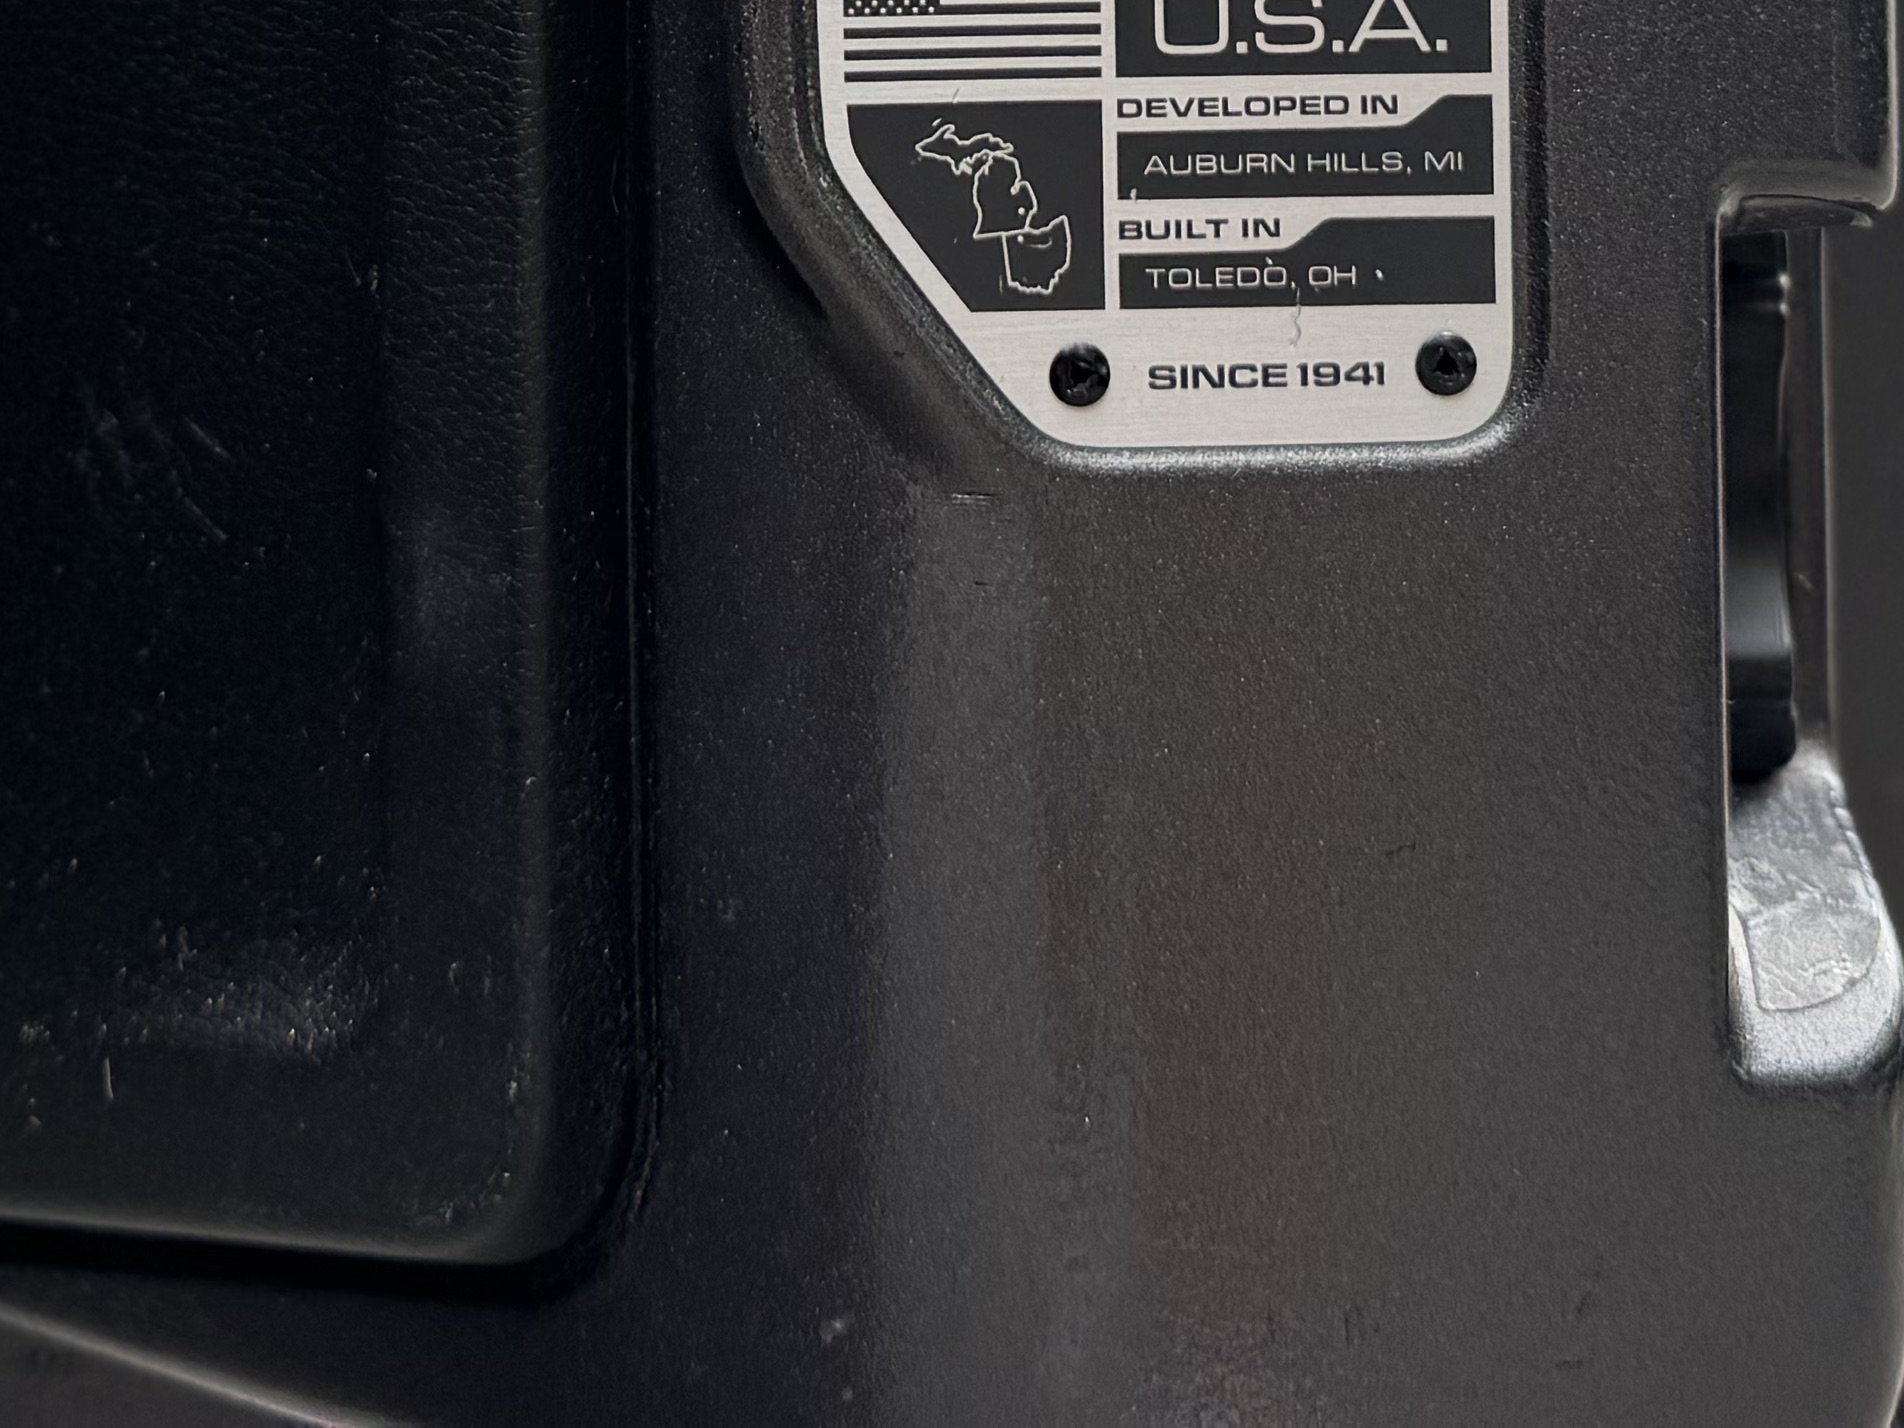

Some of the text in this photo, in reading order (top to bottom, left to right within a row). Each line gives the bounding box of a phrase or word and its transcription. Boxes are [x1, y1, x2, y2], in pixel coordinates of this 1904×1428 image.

[1116, 94, 1399, 119] DEVELOPED IN
[1143, 150, 1463, 175] AUBURN HILLS, MI
[1118, 217, 1281, 241] BUILT IN
[1145, 265, 1357, 289] TOLEDO, OH
[1148, 361, 1385, 391] SINCE 1941
